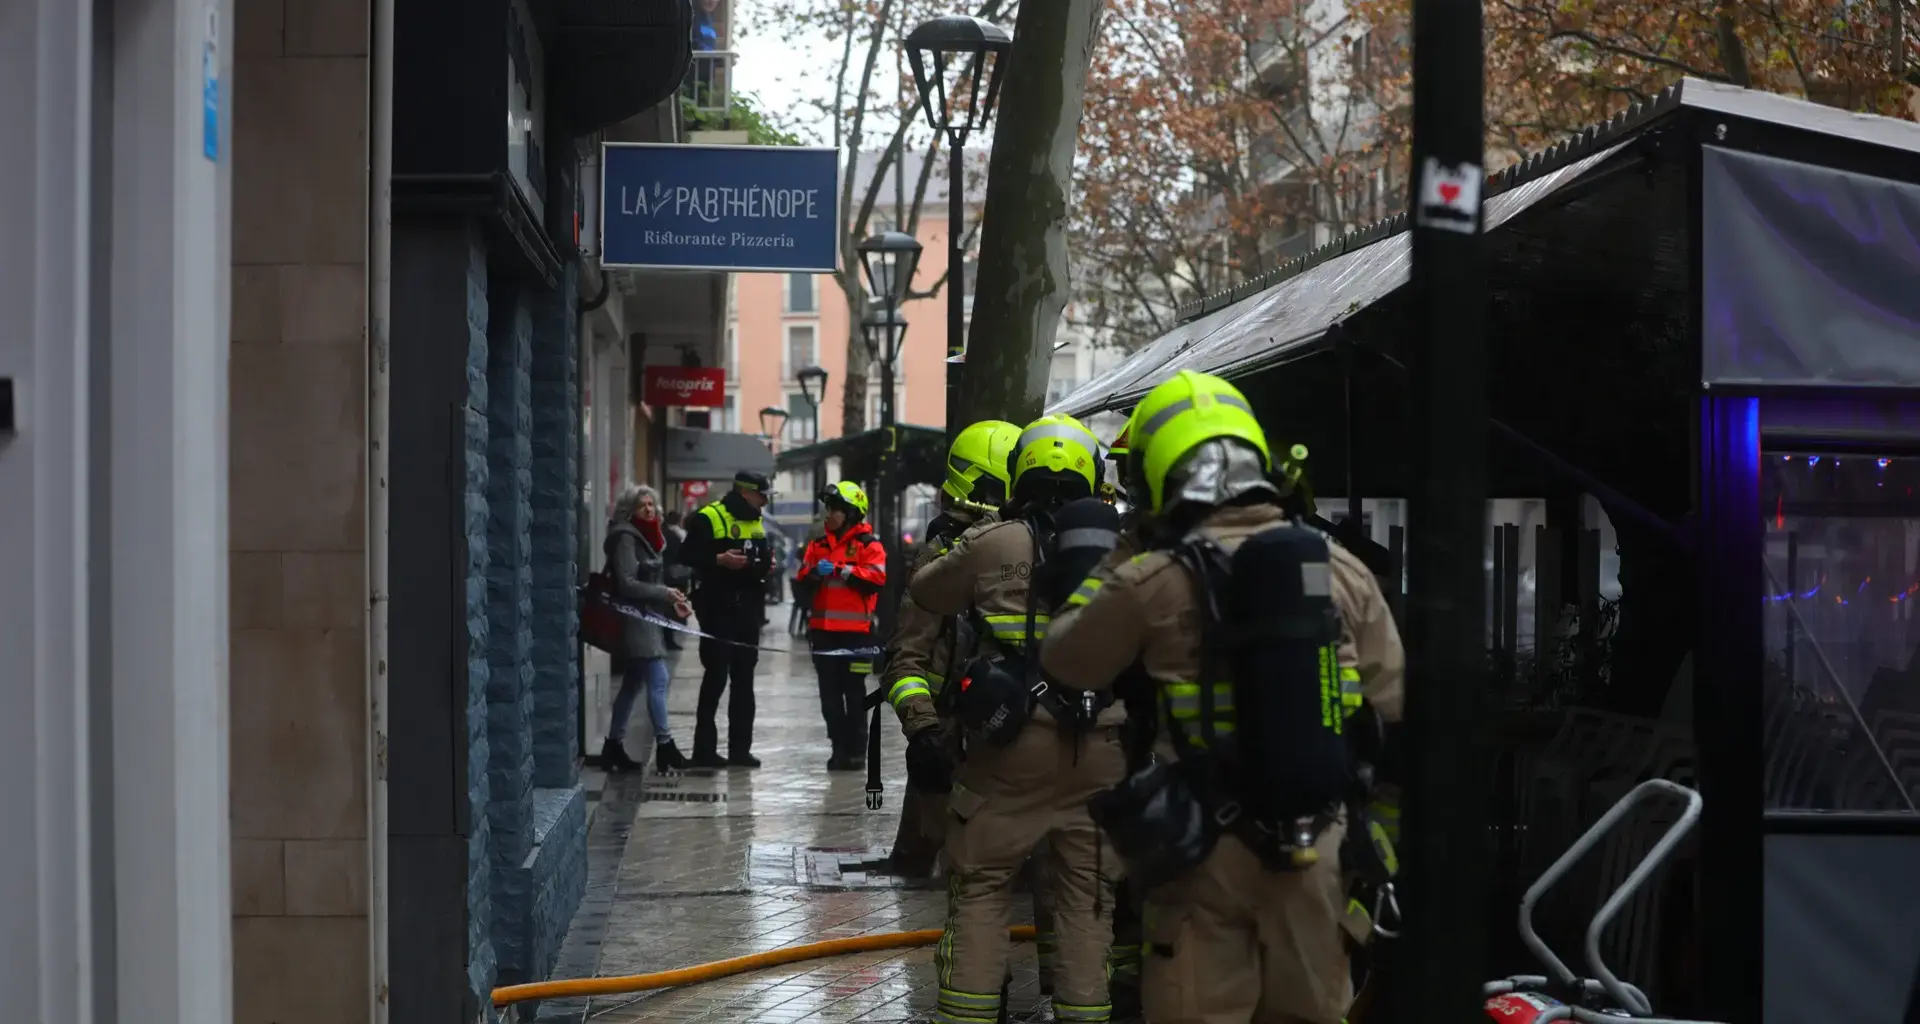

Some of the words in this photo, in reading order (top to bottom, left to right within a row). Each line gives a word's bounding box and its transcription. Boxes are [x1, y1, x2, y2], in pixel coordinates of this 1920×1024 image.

[621, 185, 648, 216] LA
[676, 184, 818, 223] PARTHÉNOPE
[643, 230, 726, 247] Ristorante
[731, 231, 794, 248] Pizzeria
[656, 376, 715, 393] fotoprix
